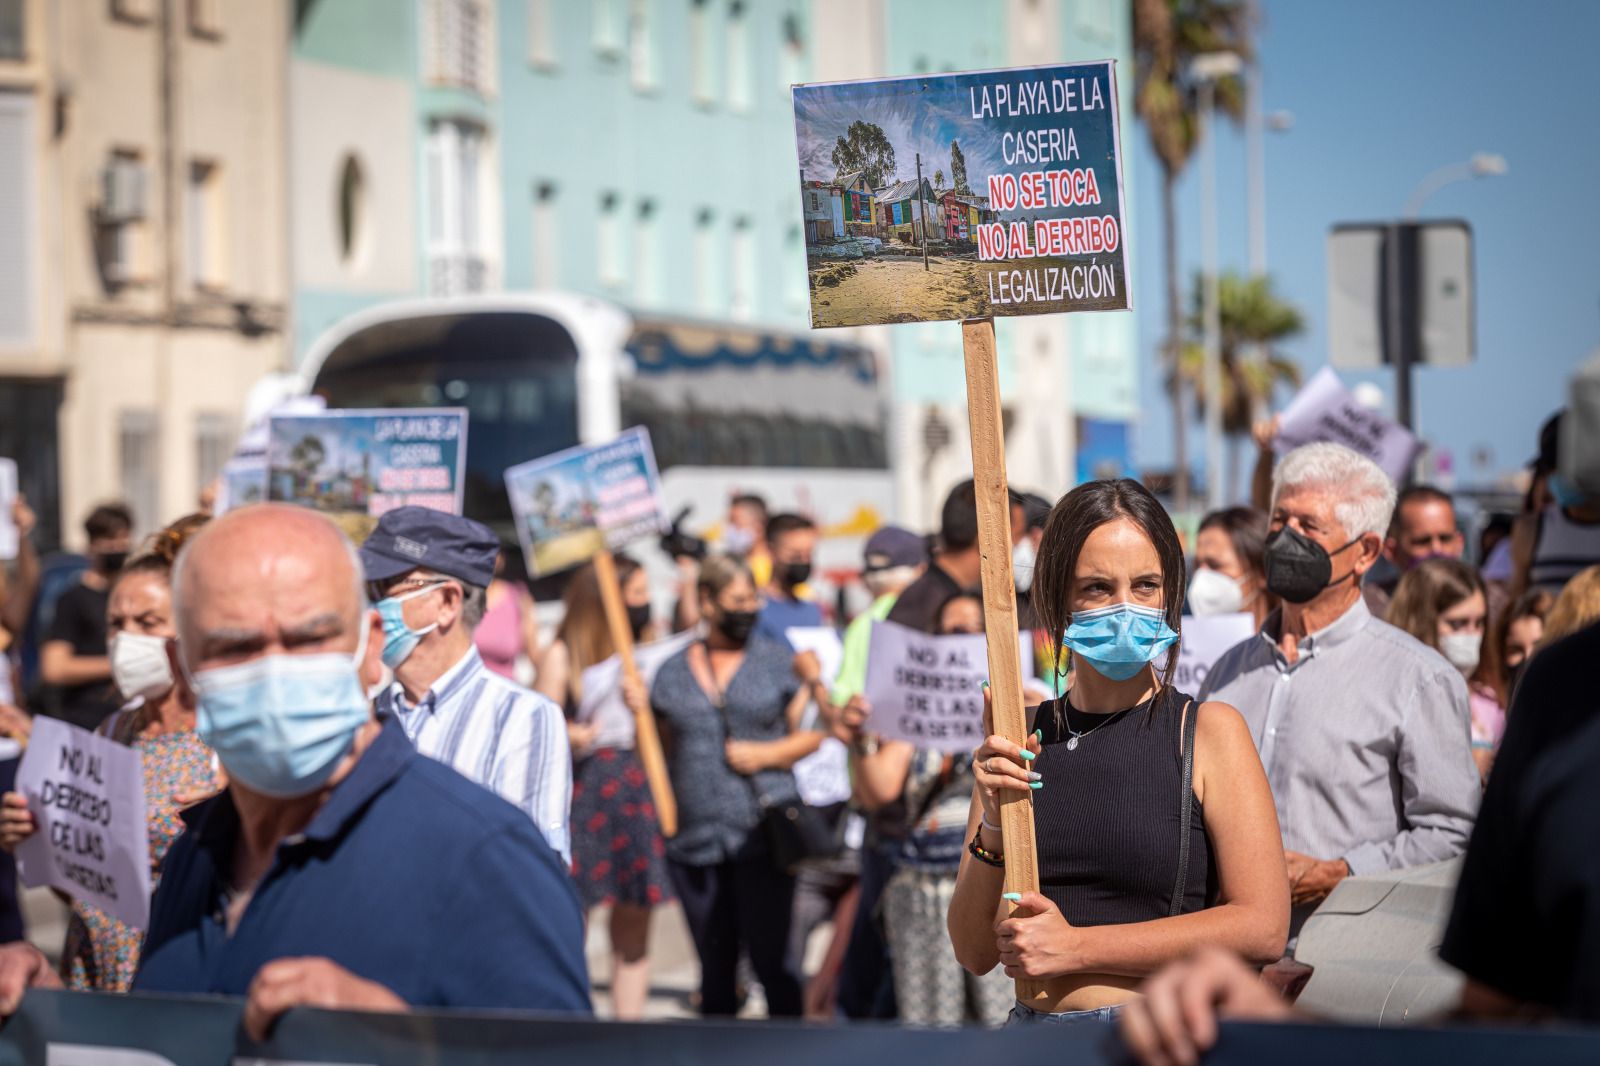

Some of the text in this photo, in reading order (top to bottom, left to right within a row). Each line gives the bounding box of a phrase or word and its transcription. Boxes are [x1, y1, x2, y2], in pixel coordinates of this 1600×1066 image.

[970, 76, 1105, 119] LA PLAYA DE LA
[1002, 127, 1080, 165] CASERIA
[988, 168, 1101, 211] NO SE TOCA
[977, 214, 1119, 261] NO AL DERRIBO
[988, 257, 1116, 305] LEGALIZACIÓN
[907, 644, 972, 669] NO AL
[904, 693, 980, 717] DE LAS
[59, 745, 105, 785] NO AL
[51, 820, 105, 861] DE LAS
